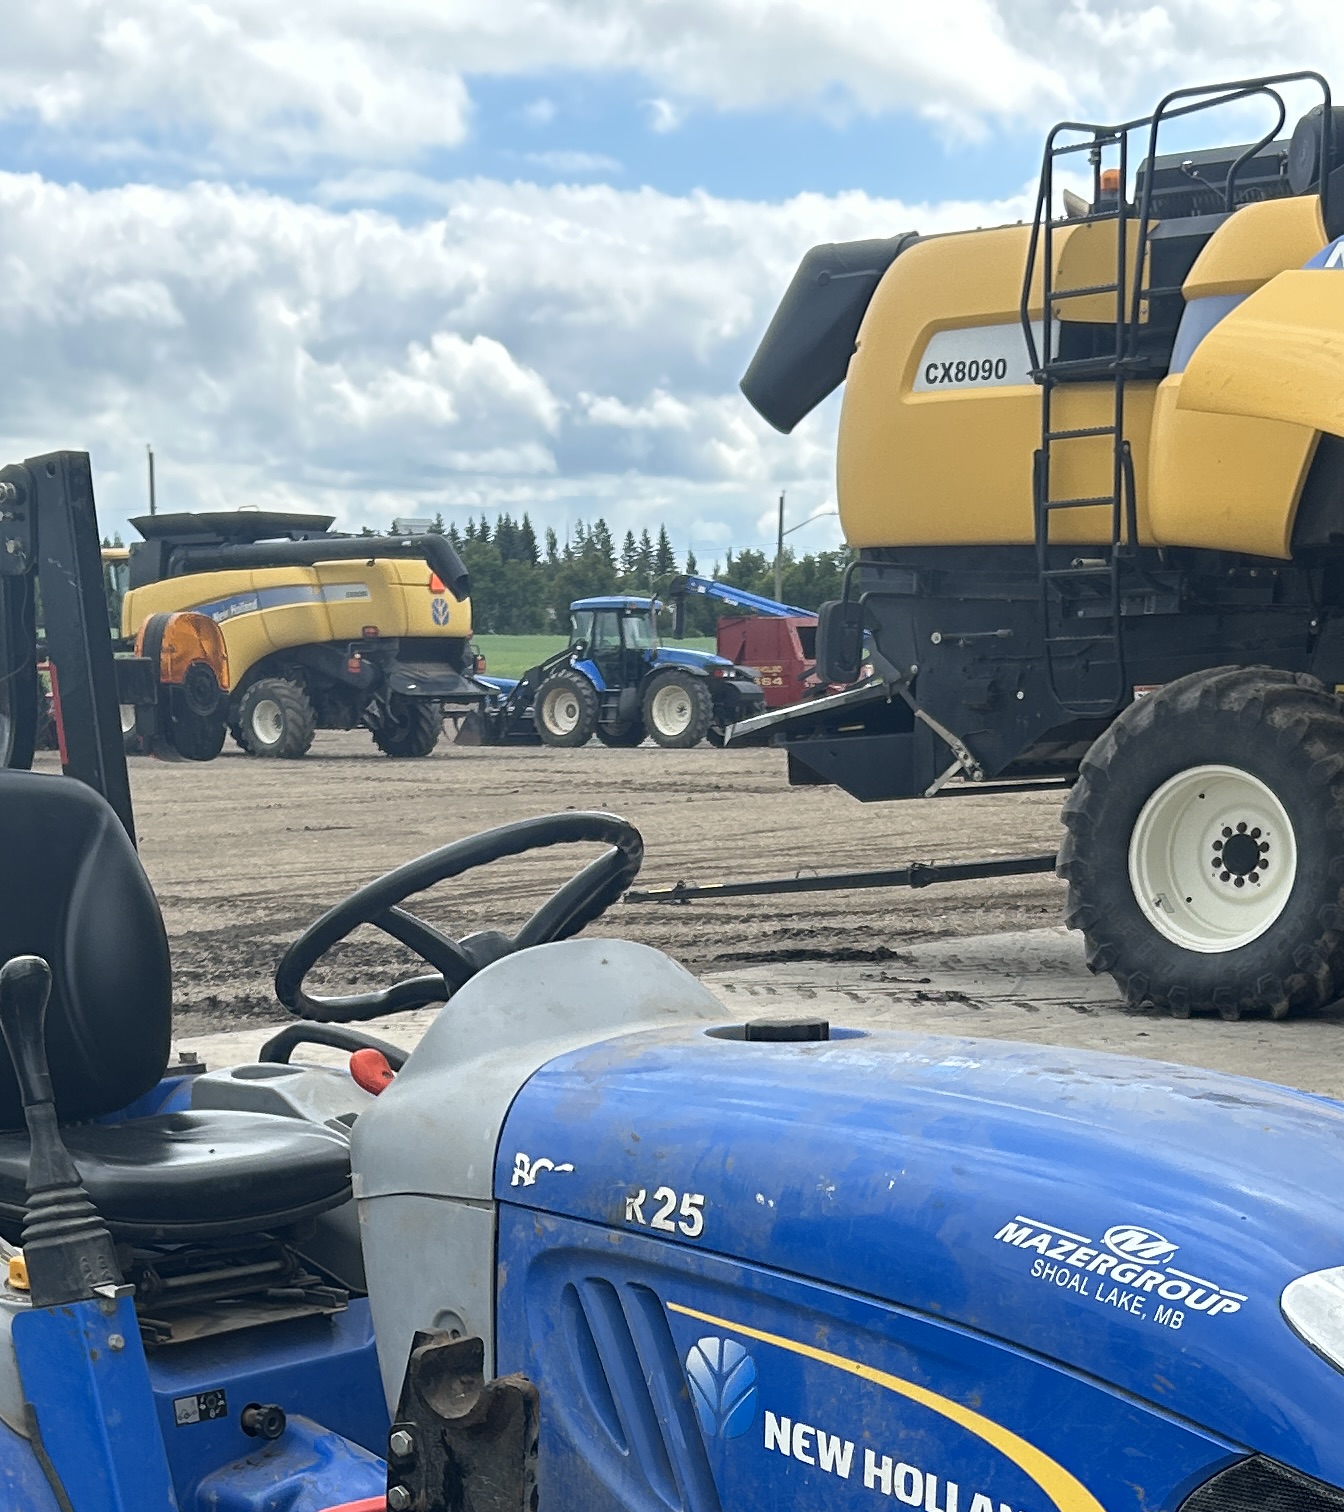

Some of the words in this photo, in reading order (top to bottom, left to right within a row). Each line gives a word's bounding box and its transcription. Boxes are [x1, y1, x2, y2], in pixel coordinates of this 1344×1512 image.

[924, 357, 1008, 385] CX8090
[993, 1222, 1243, 1317] MAZERGROUP
[1030, 1258, 1090, 1297] SHOAL
[1094, 1282, 1148, 1321] LAKE,
[1153, 1304, 1186, 1330] MB
[763, 1410, 856, 1480] NEW
